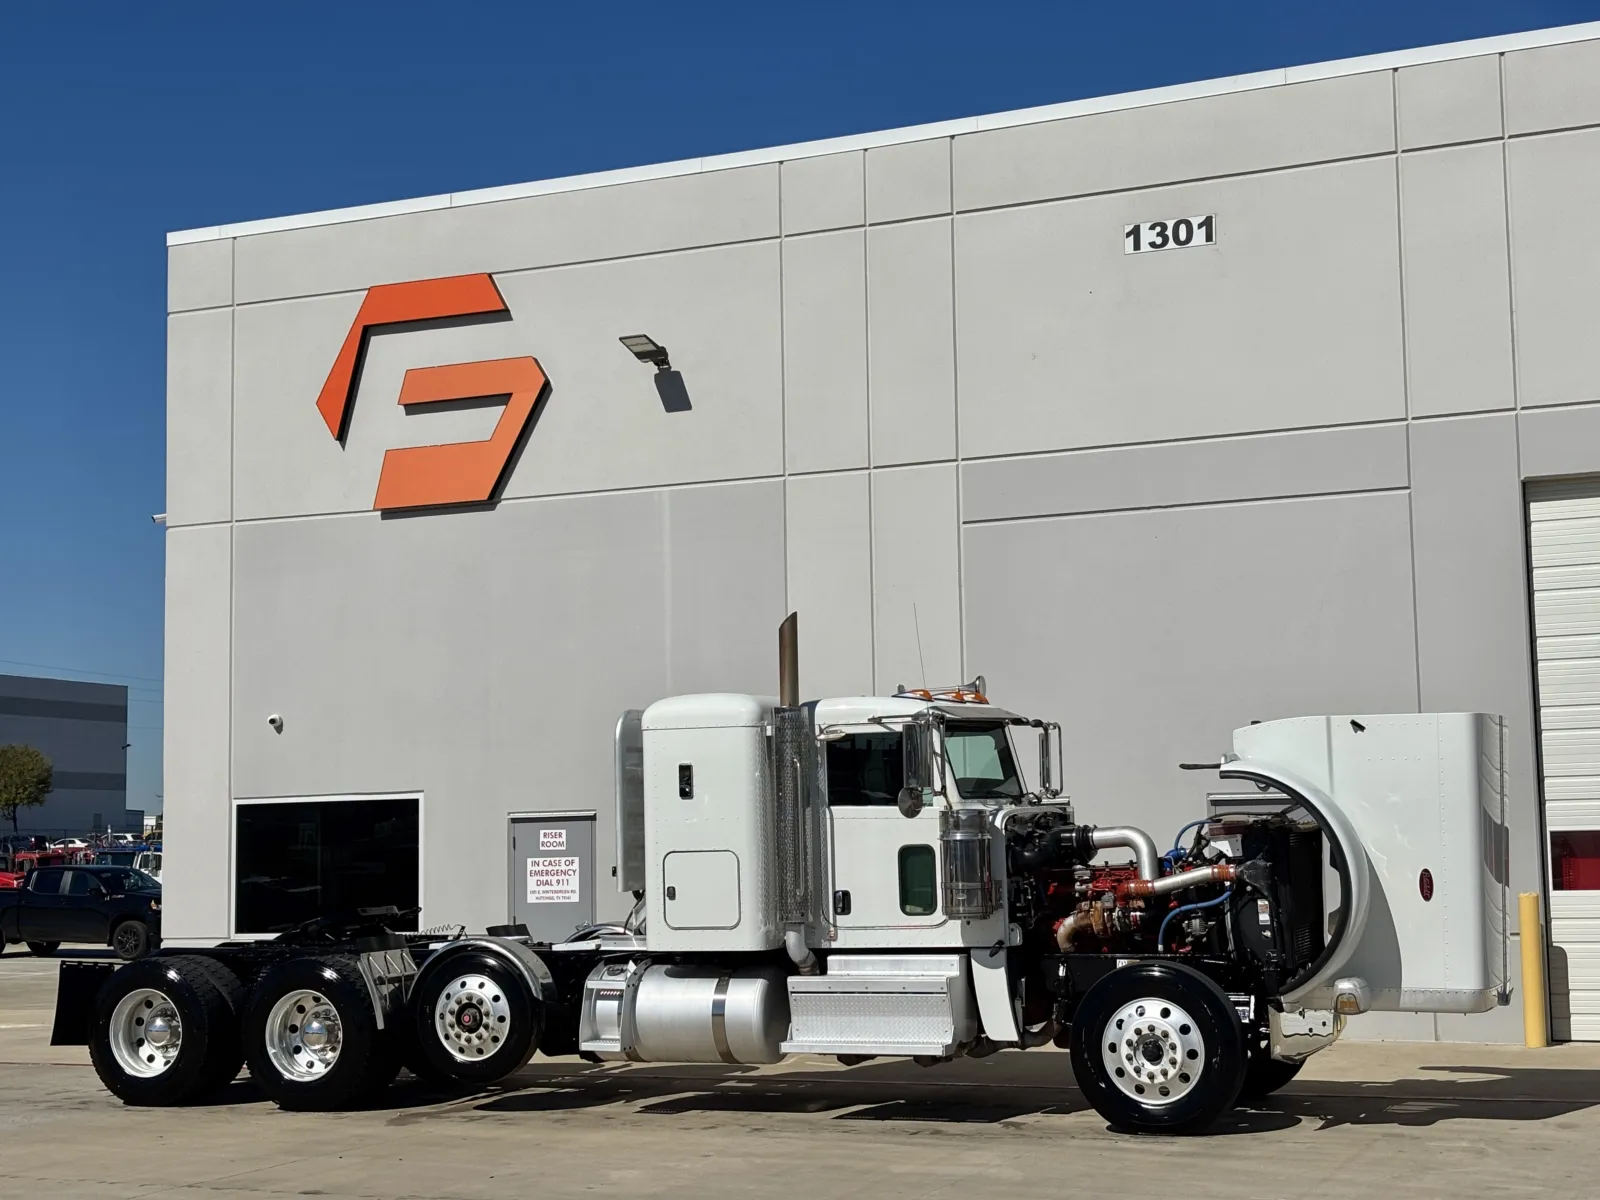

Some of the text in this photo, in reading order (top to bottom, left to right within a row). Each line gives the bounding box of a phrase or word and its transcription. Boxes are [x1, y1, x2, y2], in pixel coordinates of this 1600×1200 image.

[1125, 215, 1213, 252] 1301
[543, 831, 563, 839] RISER
[541, 840, 565, 848] ROOM
[542, 859, 562, 867] CASE
[564, 859, 575, 867] OF
[529, 869, 577, 877] EMERGENCY
[536, 879, 553, 887] DIAL
